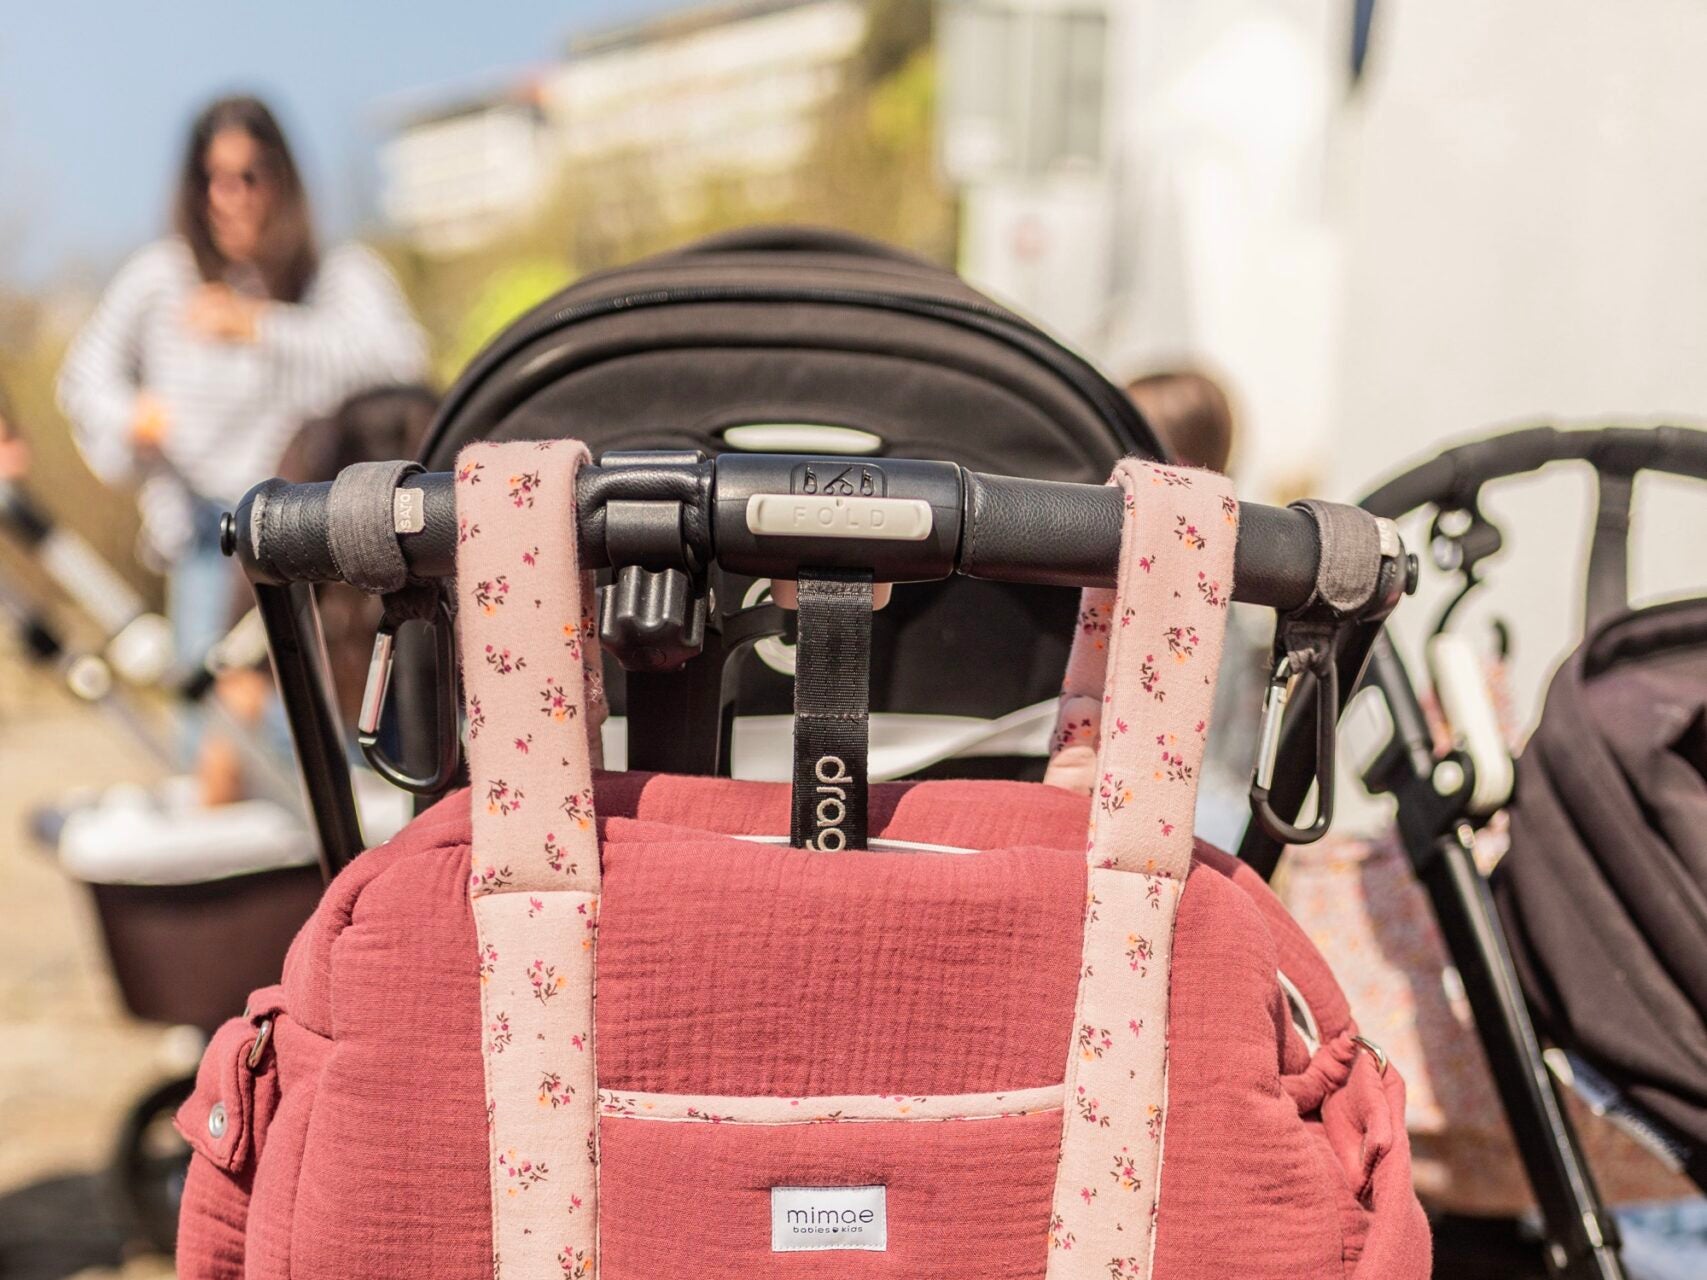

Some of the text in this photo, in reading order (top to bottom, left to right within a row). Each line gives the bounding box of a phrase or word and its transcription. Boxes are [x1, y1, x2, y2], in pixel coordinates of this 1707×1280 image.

[793, 506, 886, 528] FOLD
[787, 1206, 874, 1224] mimae
[841, 1225, 863, 1233] kids
